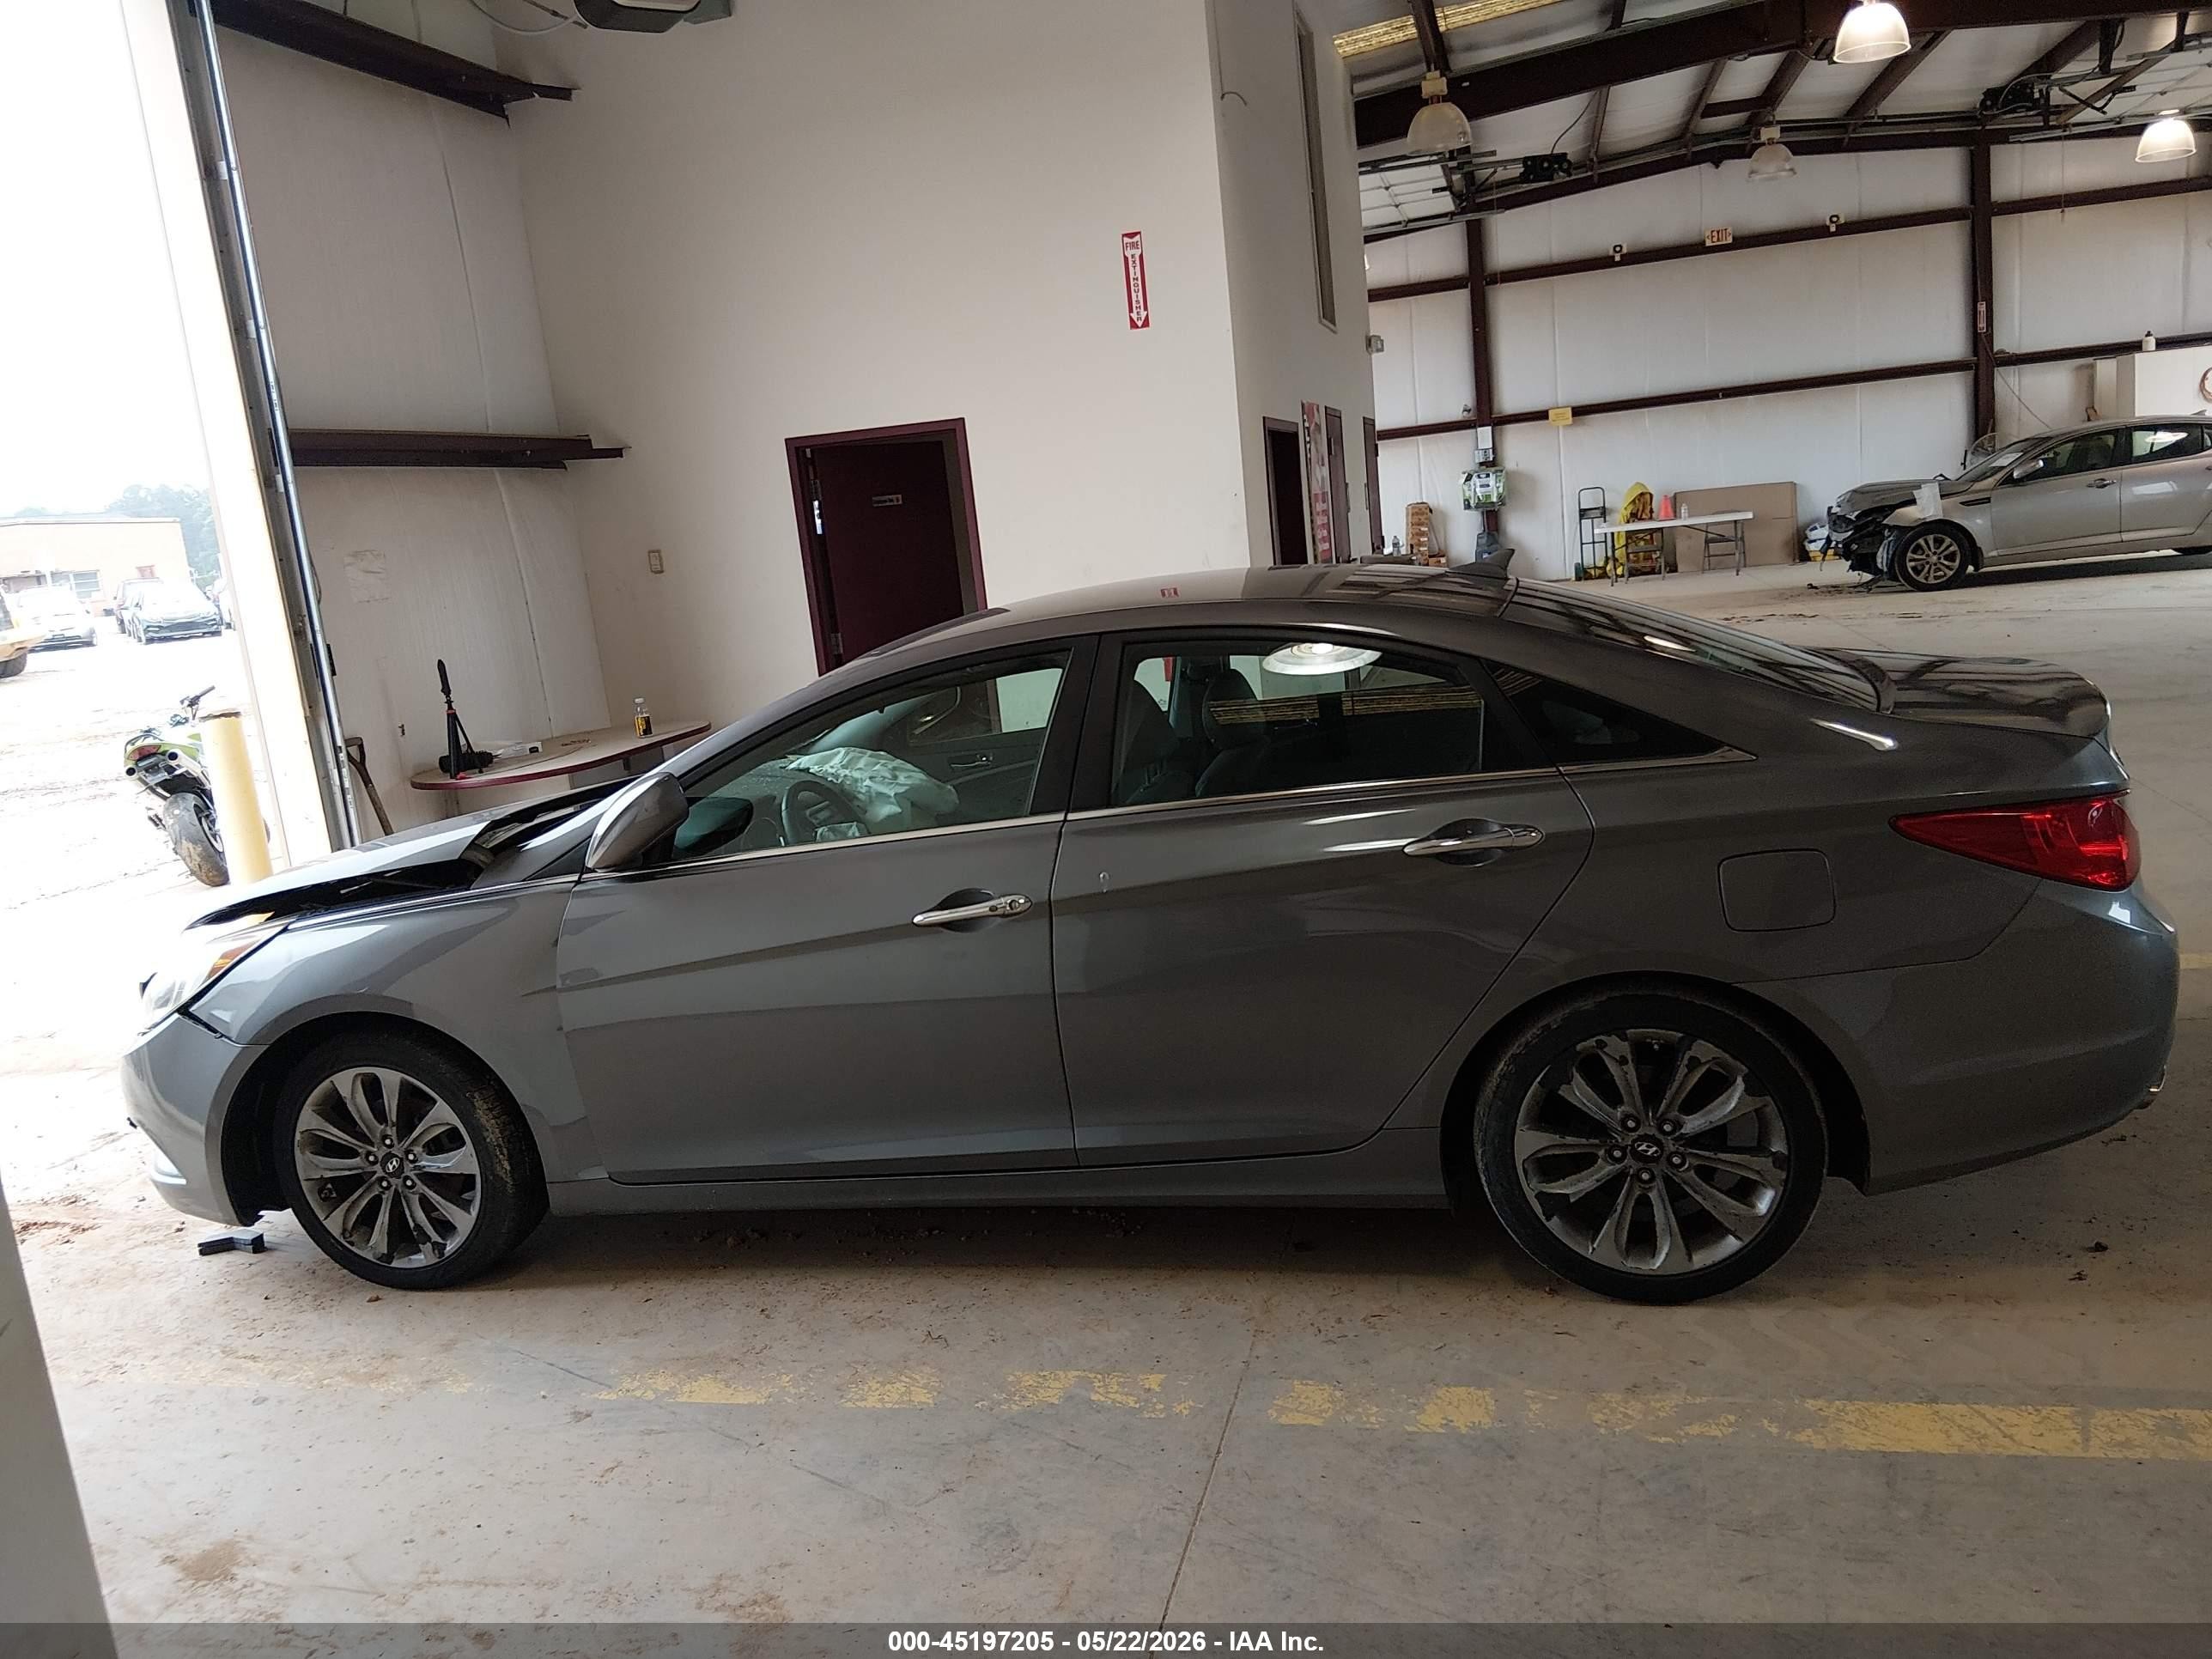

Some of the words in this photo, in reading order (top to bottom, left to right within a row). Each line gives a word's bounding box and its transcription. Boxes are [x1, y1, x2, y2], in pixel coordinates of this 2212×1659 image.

[1711, 228, 1728, 243] EXIT
[1125, 240, 1140, 251] FIRE
[1130, 253, 1143, 322] EXTINGUISHER
